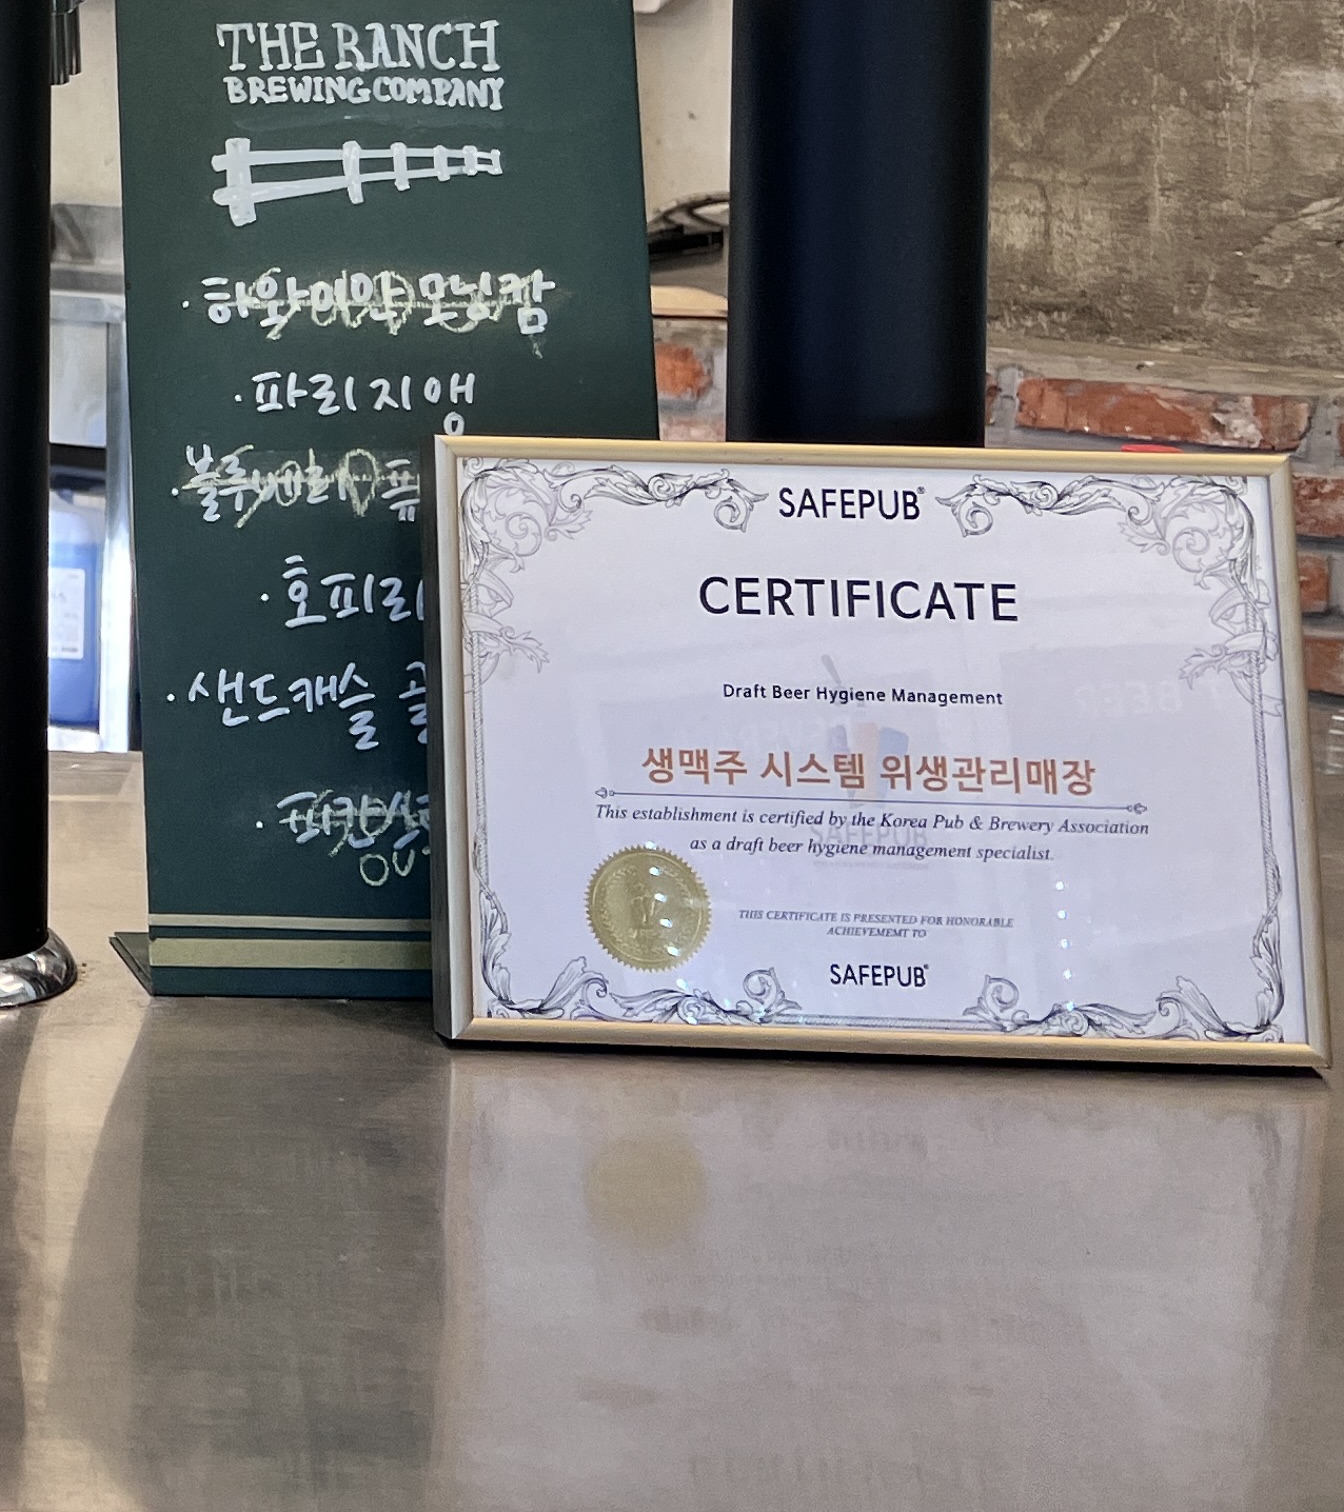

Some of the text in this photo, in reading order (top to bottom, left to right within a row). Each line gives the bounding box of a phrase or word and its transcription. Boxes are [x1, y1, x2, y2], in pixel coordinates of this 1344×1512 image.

[216, 19, 501, 72] THE RANCH
[222, 75, 504, 111] BREWING COMPANY
[251, 372, 476, 436] 파리지앵
[699, 576, 1018, 622] CERTIFICATE
[188, 662, 380, 751] 샌드캐슬
[723, 684, 1004, 707] Draft Beer Hygiene Management
[642, 747, 1097, 797] 생맥주 시스템 위생관리매장
[596, 804, 1150, 836] This establishment is certified by the Korea Pub & Brewery Association
[689, 836, 1055, 863] as a draft beer hygiene management specialist.
[738, 909, 1015, 929] THIS CERTIFICATE IS PRESENTED FOR HONORABLE
[912, 928, 928, 939] TO
